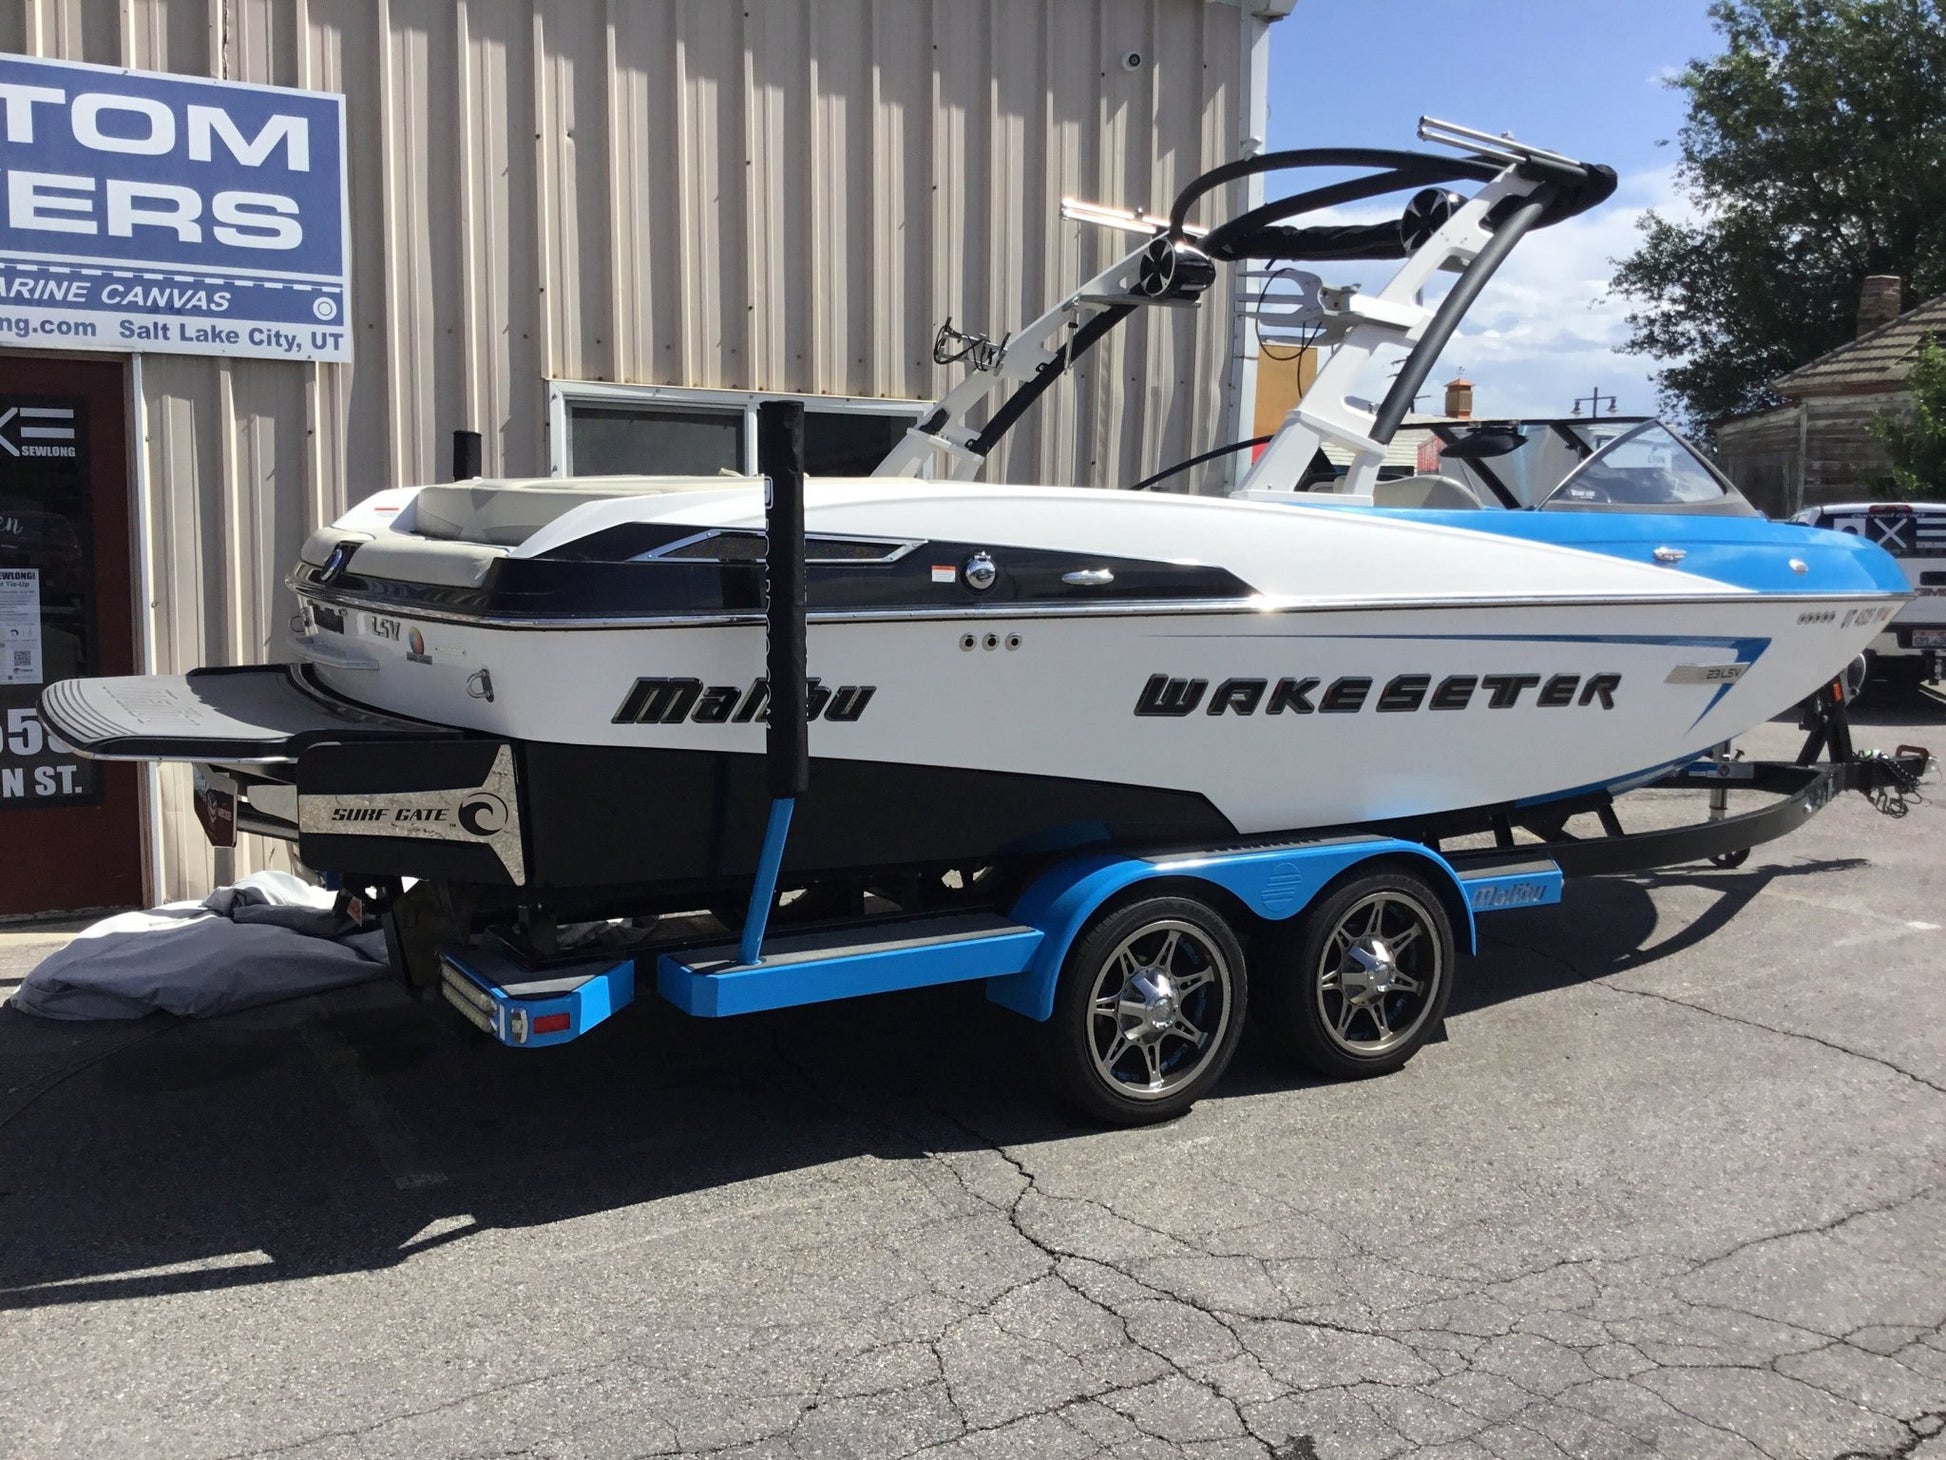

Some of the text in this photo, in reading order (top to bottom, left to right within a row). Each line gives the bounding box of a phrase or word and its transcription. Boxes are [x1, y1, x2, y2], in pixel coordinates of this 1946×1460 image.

[0, 83, 310, 172] TOM
[7, 169, 304, 250] ERS
[101, 284, 231, 312] CANVAS
[119, 319, 170, 341] Salt
[179, 323, 240, 345] Lake
[248, 327, 302, 353] City,
[311, 331, 344, 351] UT
[21, 446, 76, 457] SEWLONG
[611, 677, 878, 724] Malbu
[1133, 672, 1622, 717] WAKESETTER
[34, 765, 83, 796] ST.
[331, 808, 390, 821] SURF
[395, 808, 449, 821] GATE
